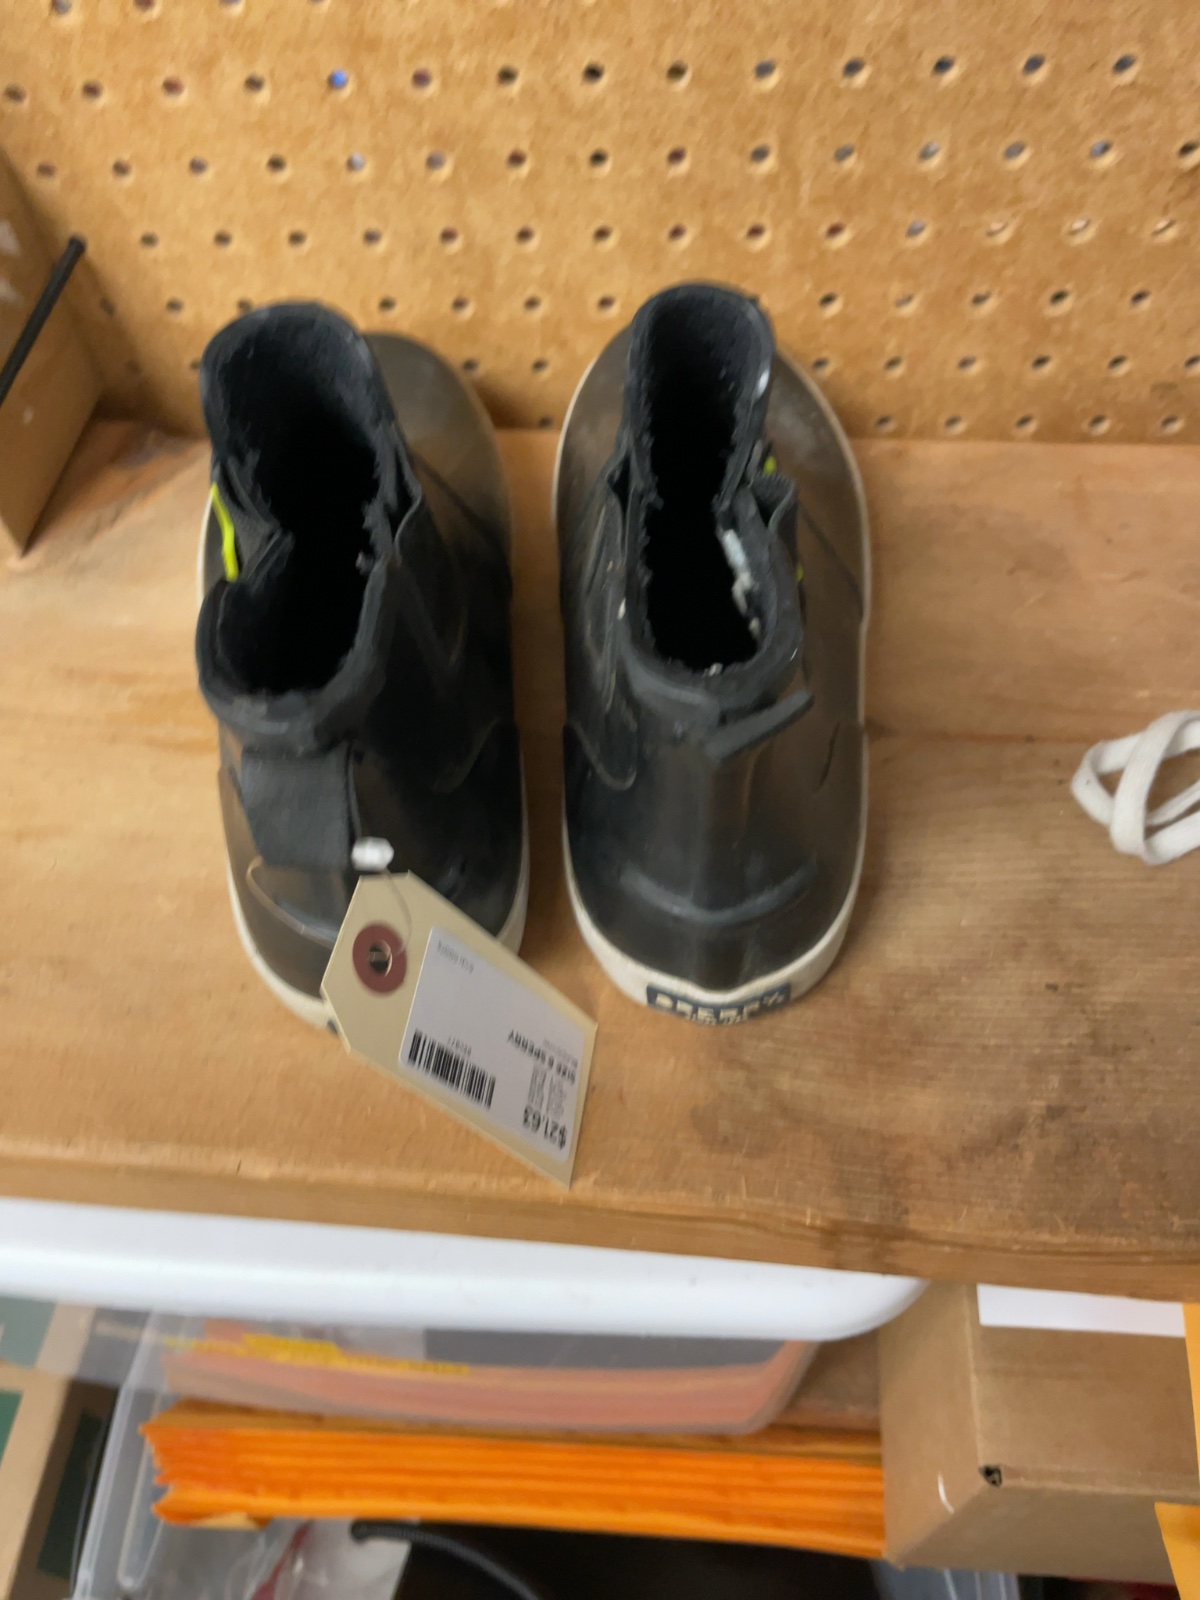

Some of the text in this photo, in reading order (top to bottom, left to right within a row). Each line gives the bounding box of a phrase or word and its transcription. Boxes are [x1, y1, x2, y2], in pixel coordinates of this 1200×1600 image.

[507, 1029, 547, 1065] SPERRY
[556, 1063, 576, 1086] SIZE
[523, 1105, 567, 1150] $21.63
